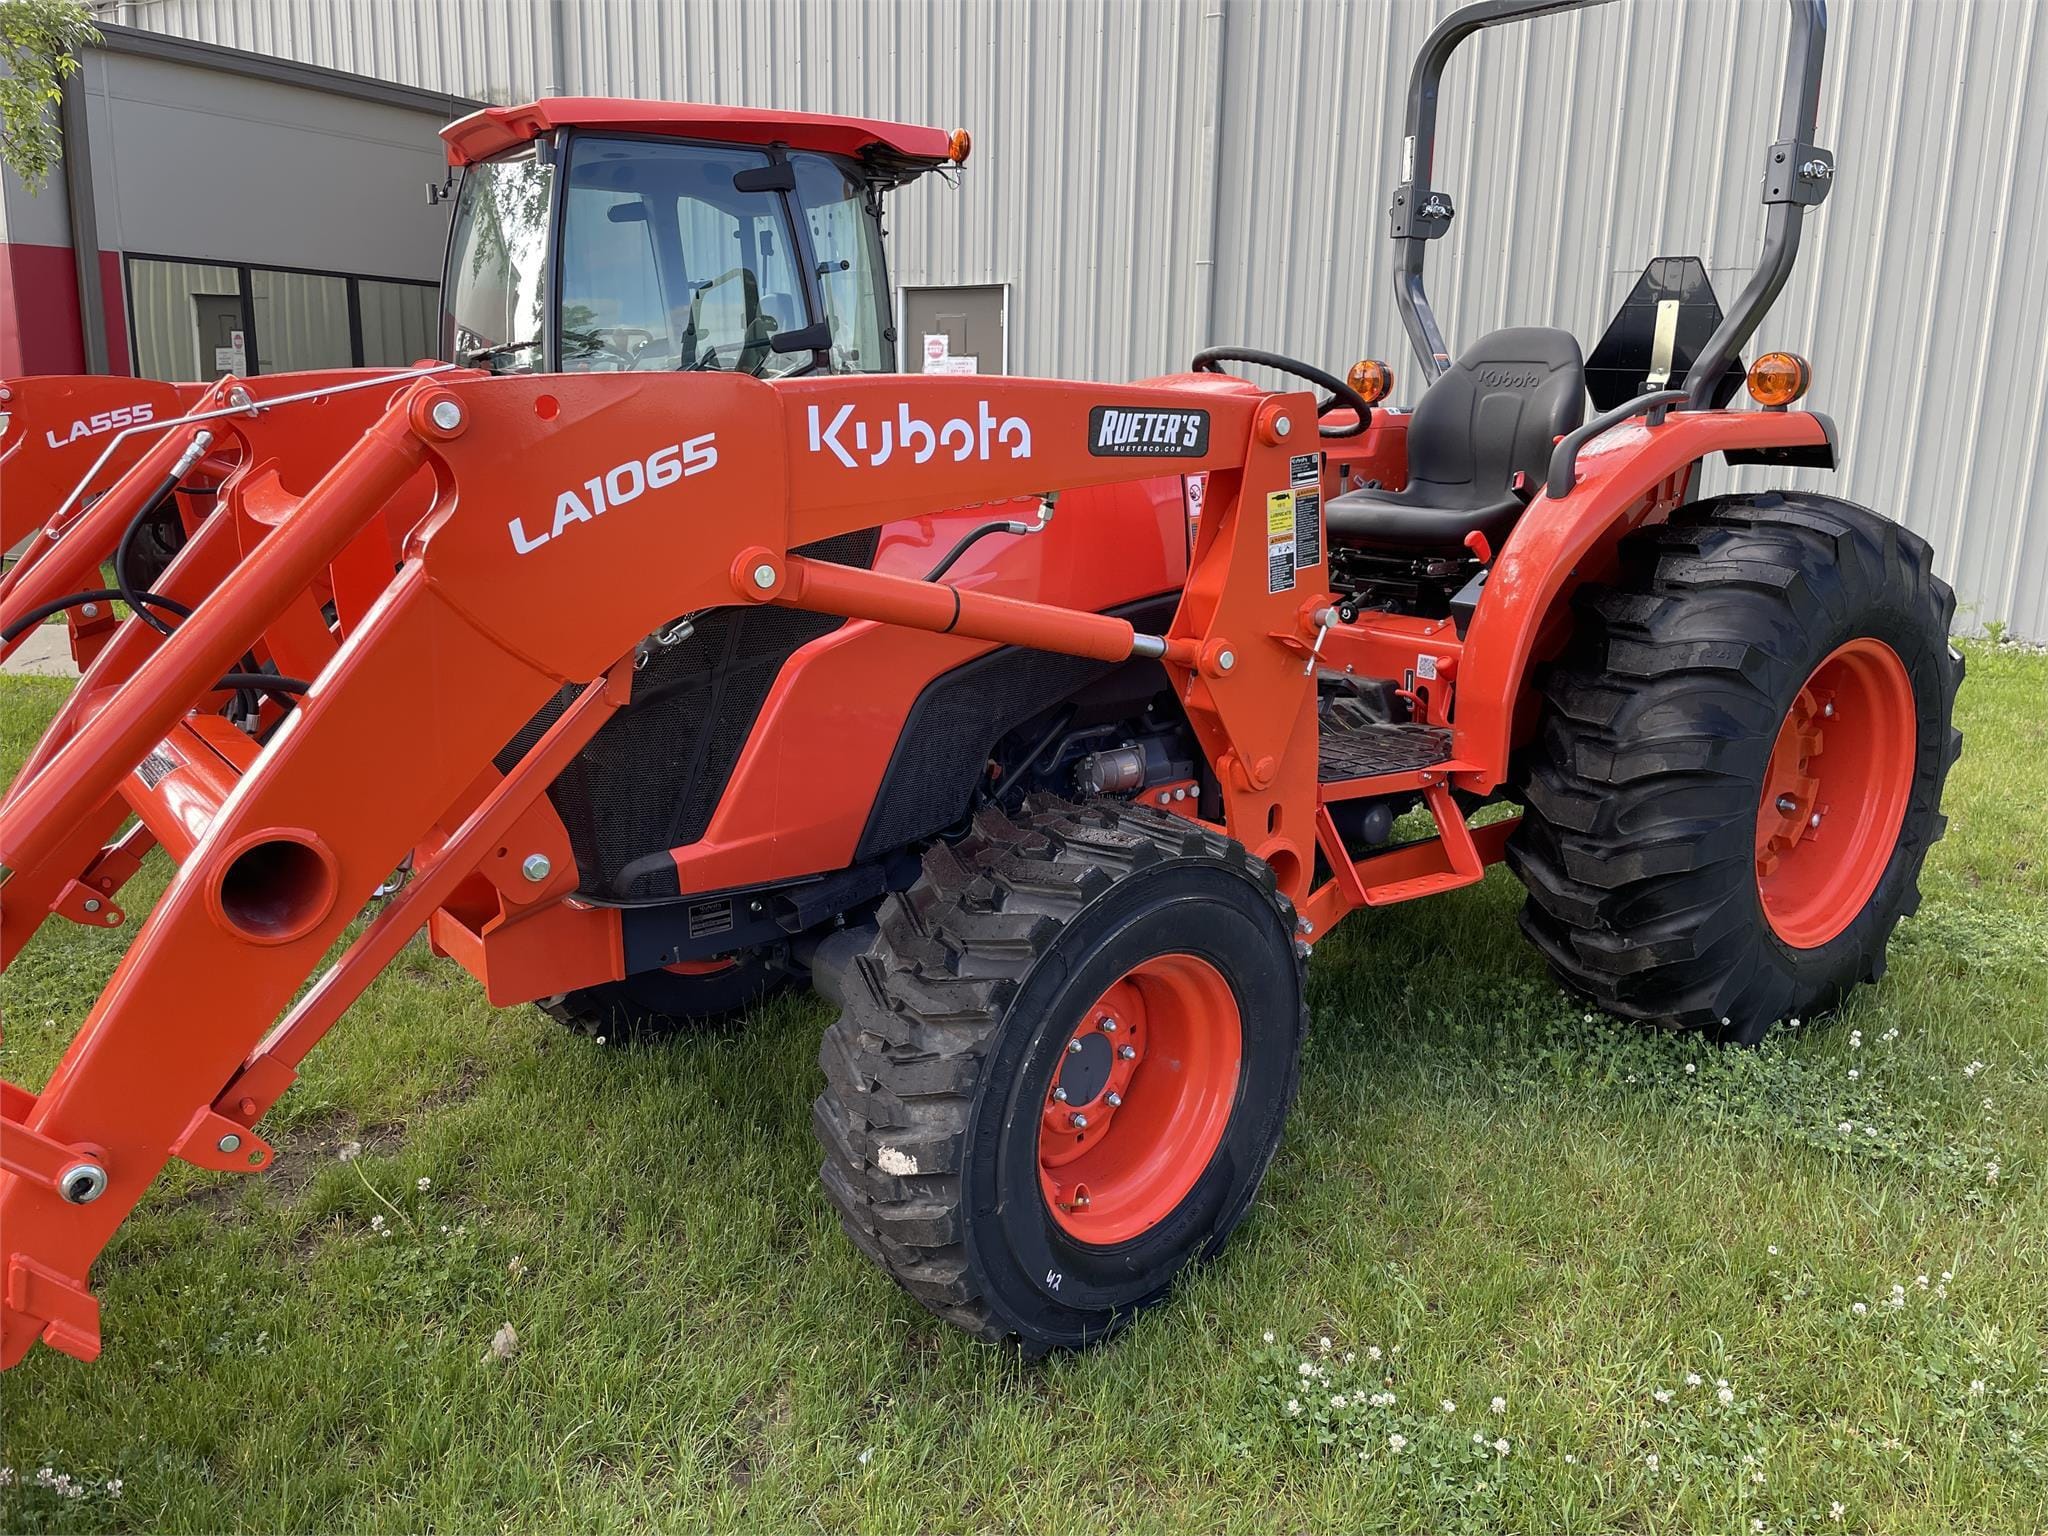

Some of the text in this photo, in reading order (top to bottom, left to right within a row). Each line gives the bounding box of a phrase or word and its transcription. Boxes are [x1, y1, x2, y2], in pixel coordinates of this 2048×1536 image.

[1479, 370, 1540, 388] Kubota
[46, 403, 154, 449] LA555
[807, 400, 1032, 468] Kubota
[1098, 410, 1201, 447] RUETER'S
[1113, 445, 1182, 453] RUETERCO.COM
[508, 432, 718, 555] LA1065
[1046, 1269, 1062, 1292] 42
